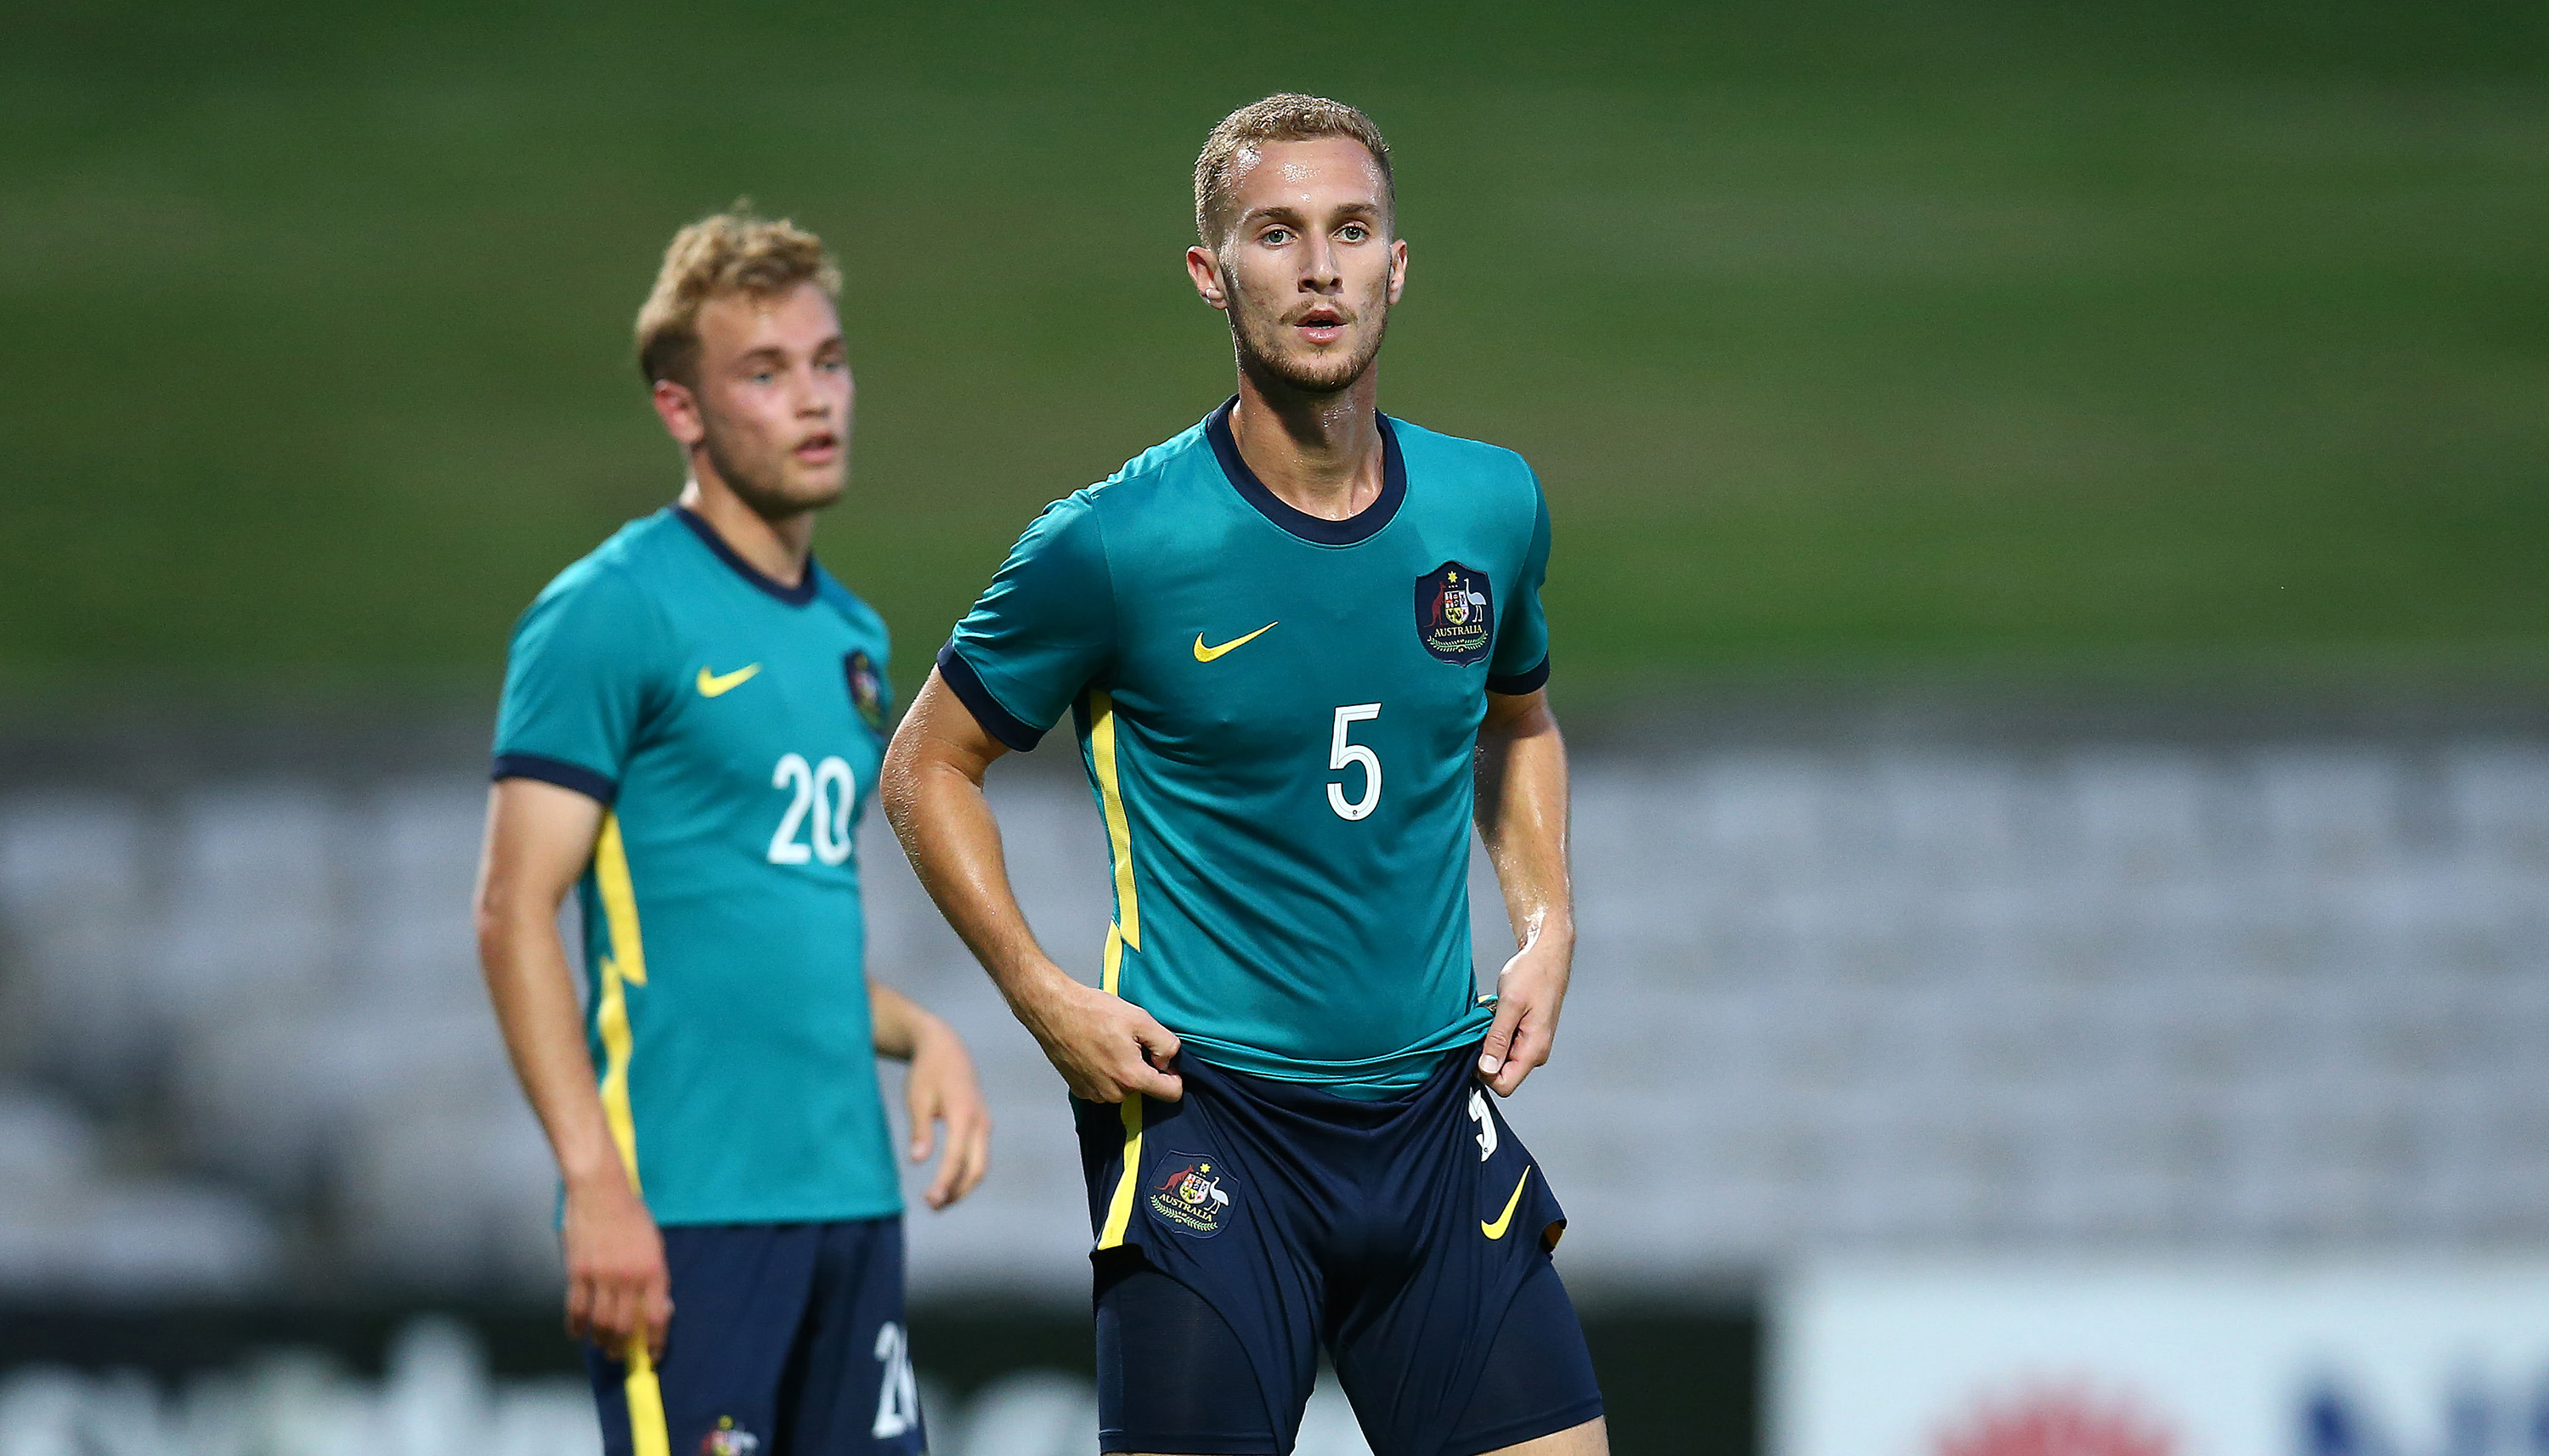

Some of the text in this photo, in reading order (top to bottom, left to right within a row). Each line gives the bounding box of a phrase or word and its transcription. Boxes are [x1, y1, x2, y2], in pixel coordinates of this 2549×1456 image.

[1434, 624, 1483, 638] AUSTRALIA
[1325, 703, 1382, 821] 5
[767, 753, 856, 866] 20
[1158, 1193, 1213, 1222] AUSTRALIA
